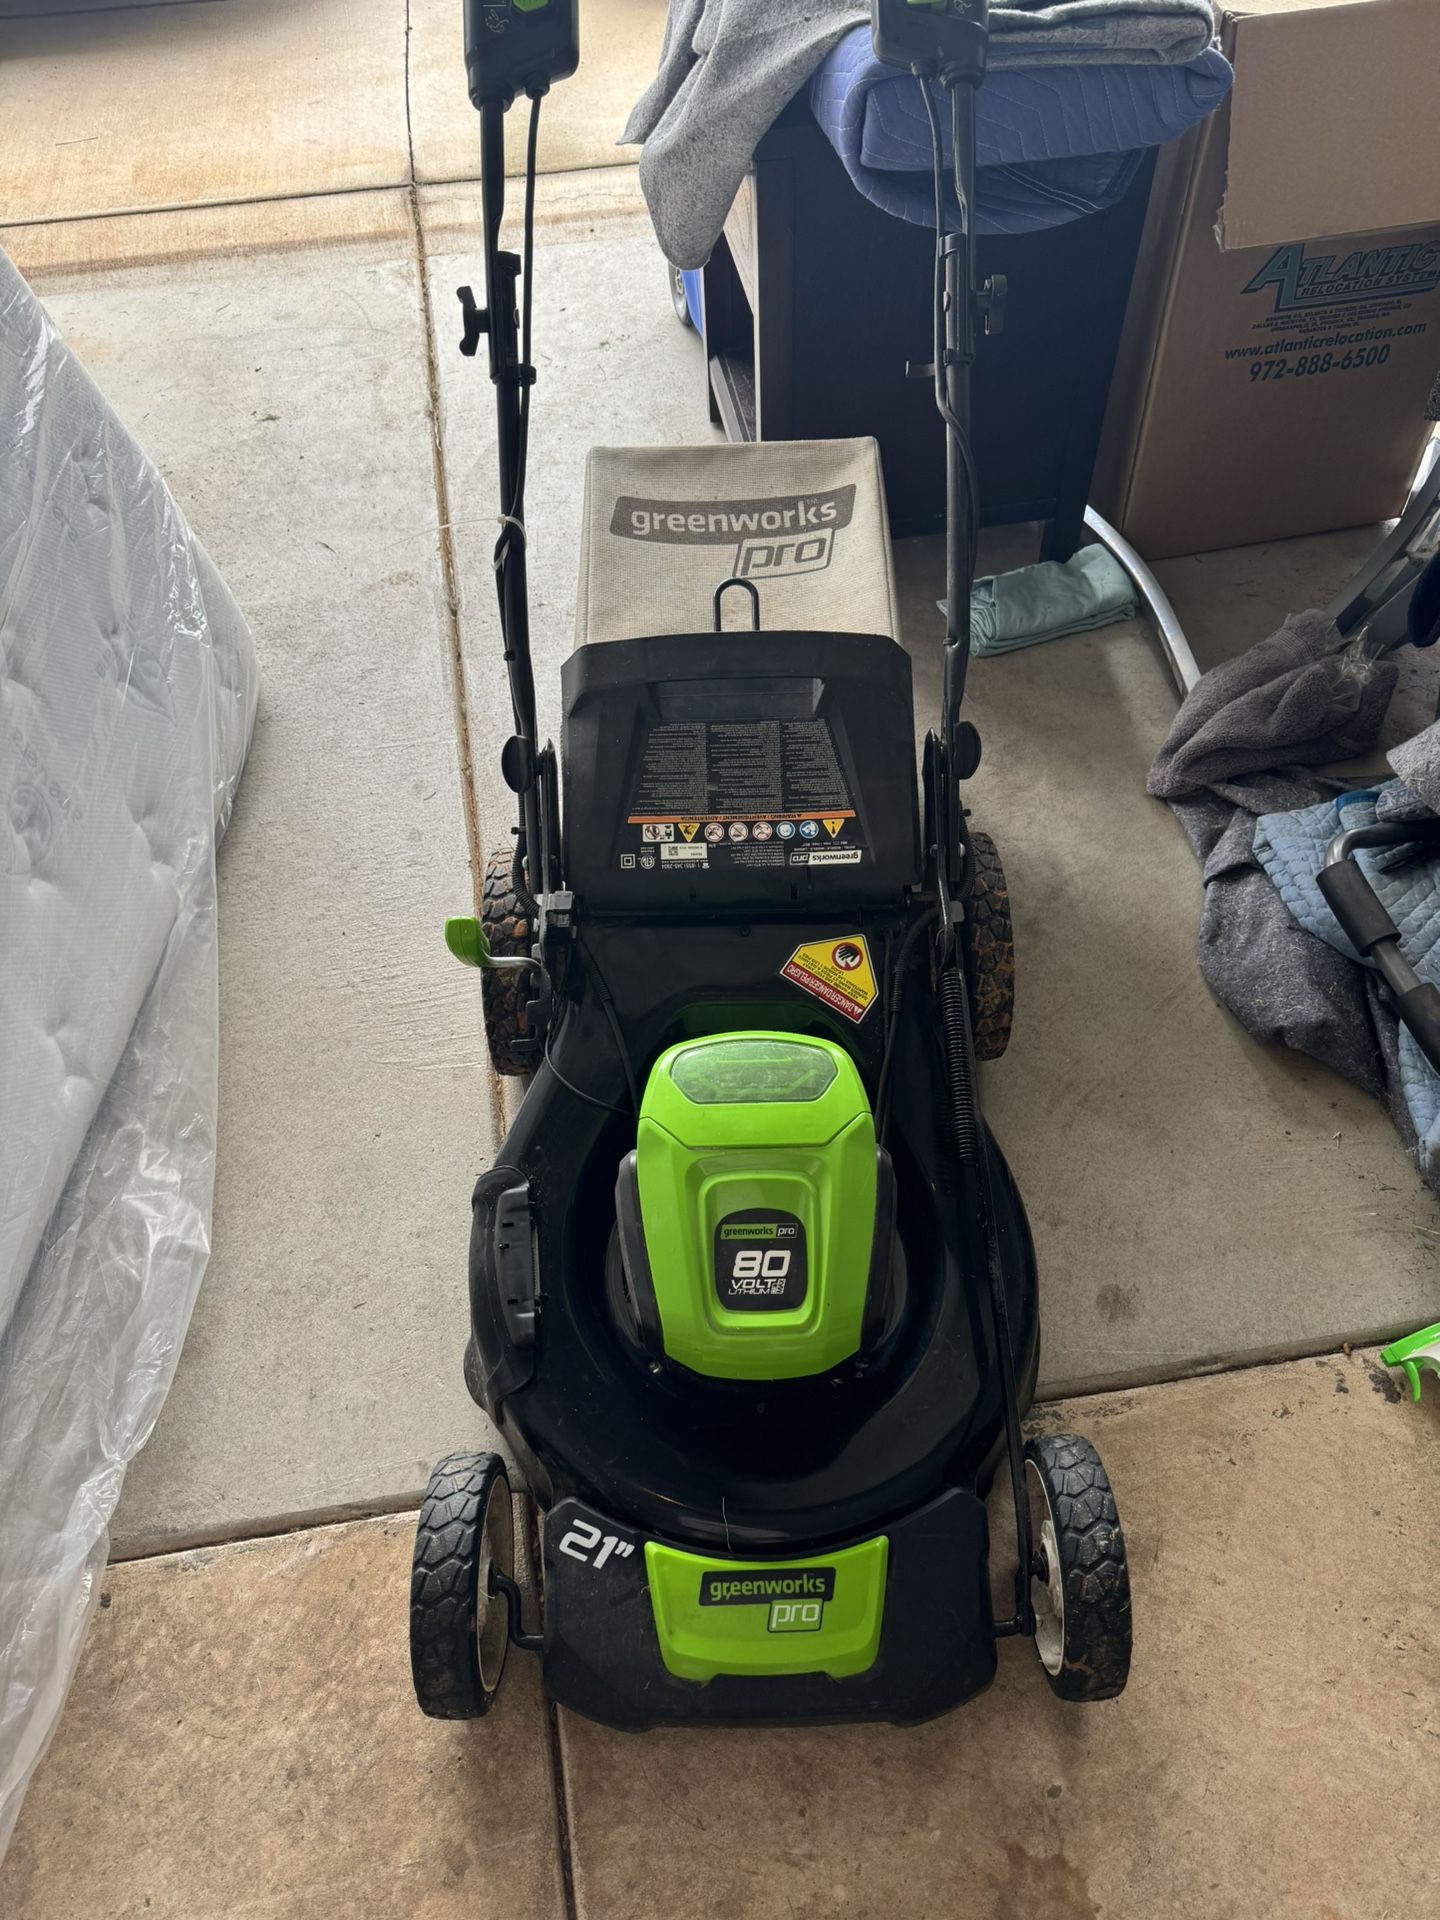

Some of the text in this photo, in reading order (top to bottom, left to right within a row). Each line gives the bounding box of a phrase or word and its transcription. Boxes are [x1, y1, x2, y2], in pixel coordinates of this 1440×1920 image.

[1240, 242, 1440, 312] ATLANTIC
[1301, 277, 1386, 297] RELOCATION
[1224, 322, 1427, 360] www.atlanticrelocation.com
[1250, 343, 1392, 382] 972-888-6500
[630, 501, 838, 536] greenworks
[741, 537, 827, 577] pro
[792, 852, 858, 862] greenworks pro
[786, 963, 854, 1011] DANGER DANGER PELIGRO
[724, 1226, 795, 1238] greenworks pro
[732, 1250, 791, 1278] 80
[731, 1279, 777, 1289] VOLT
[710, 1573, 826, 1601] greenworks
[772, 1603, 820, 1629] pro
